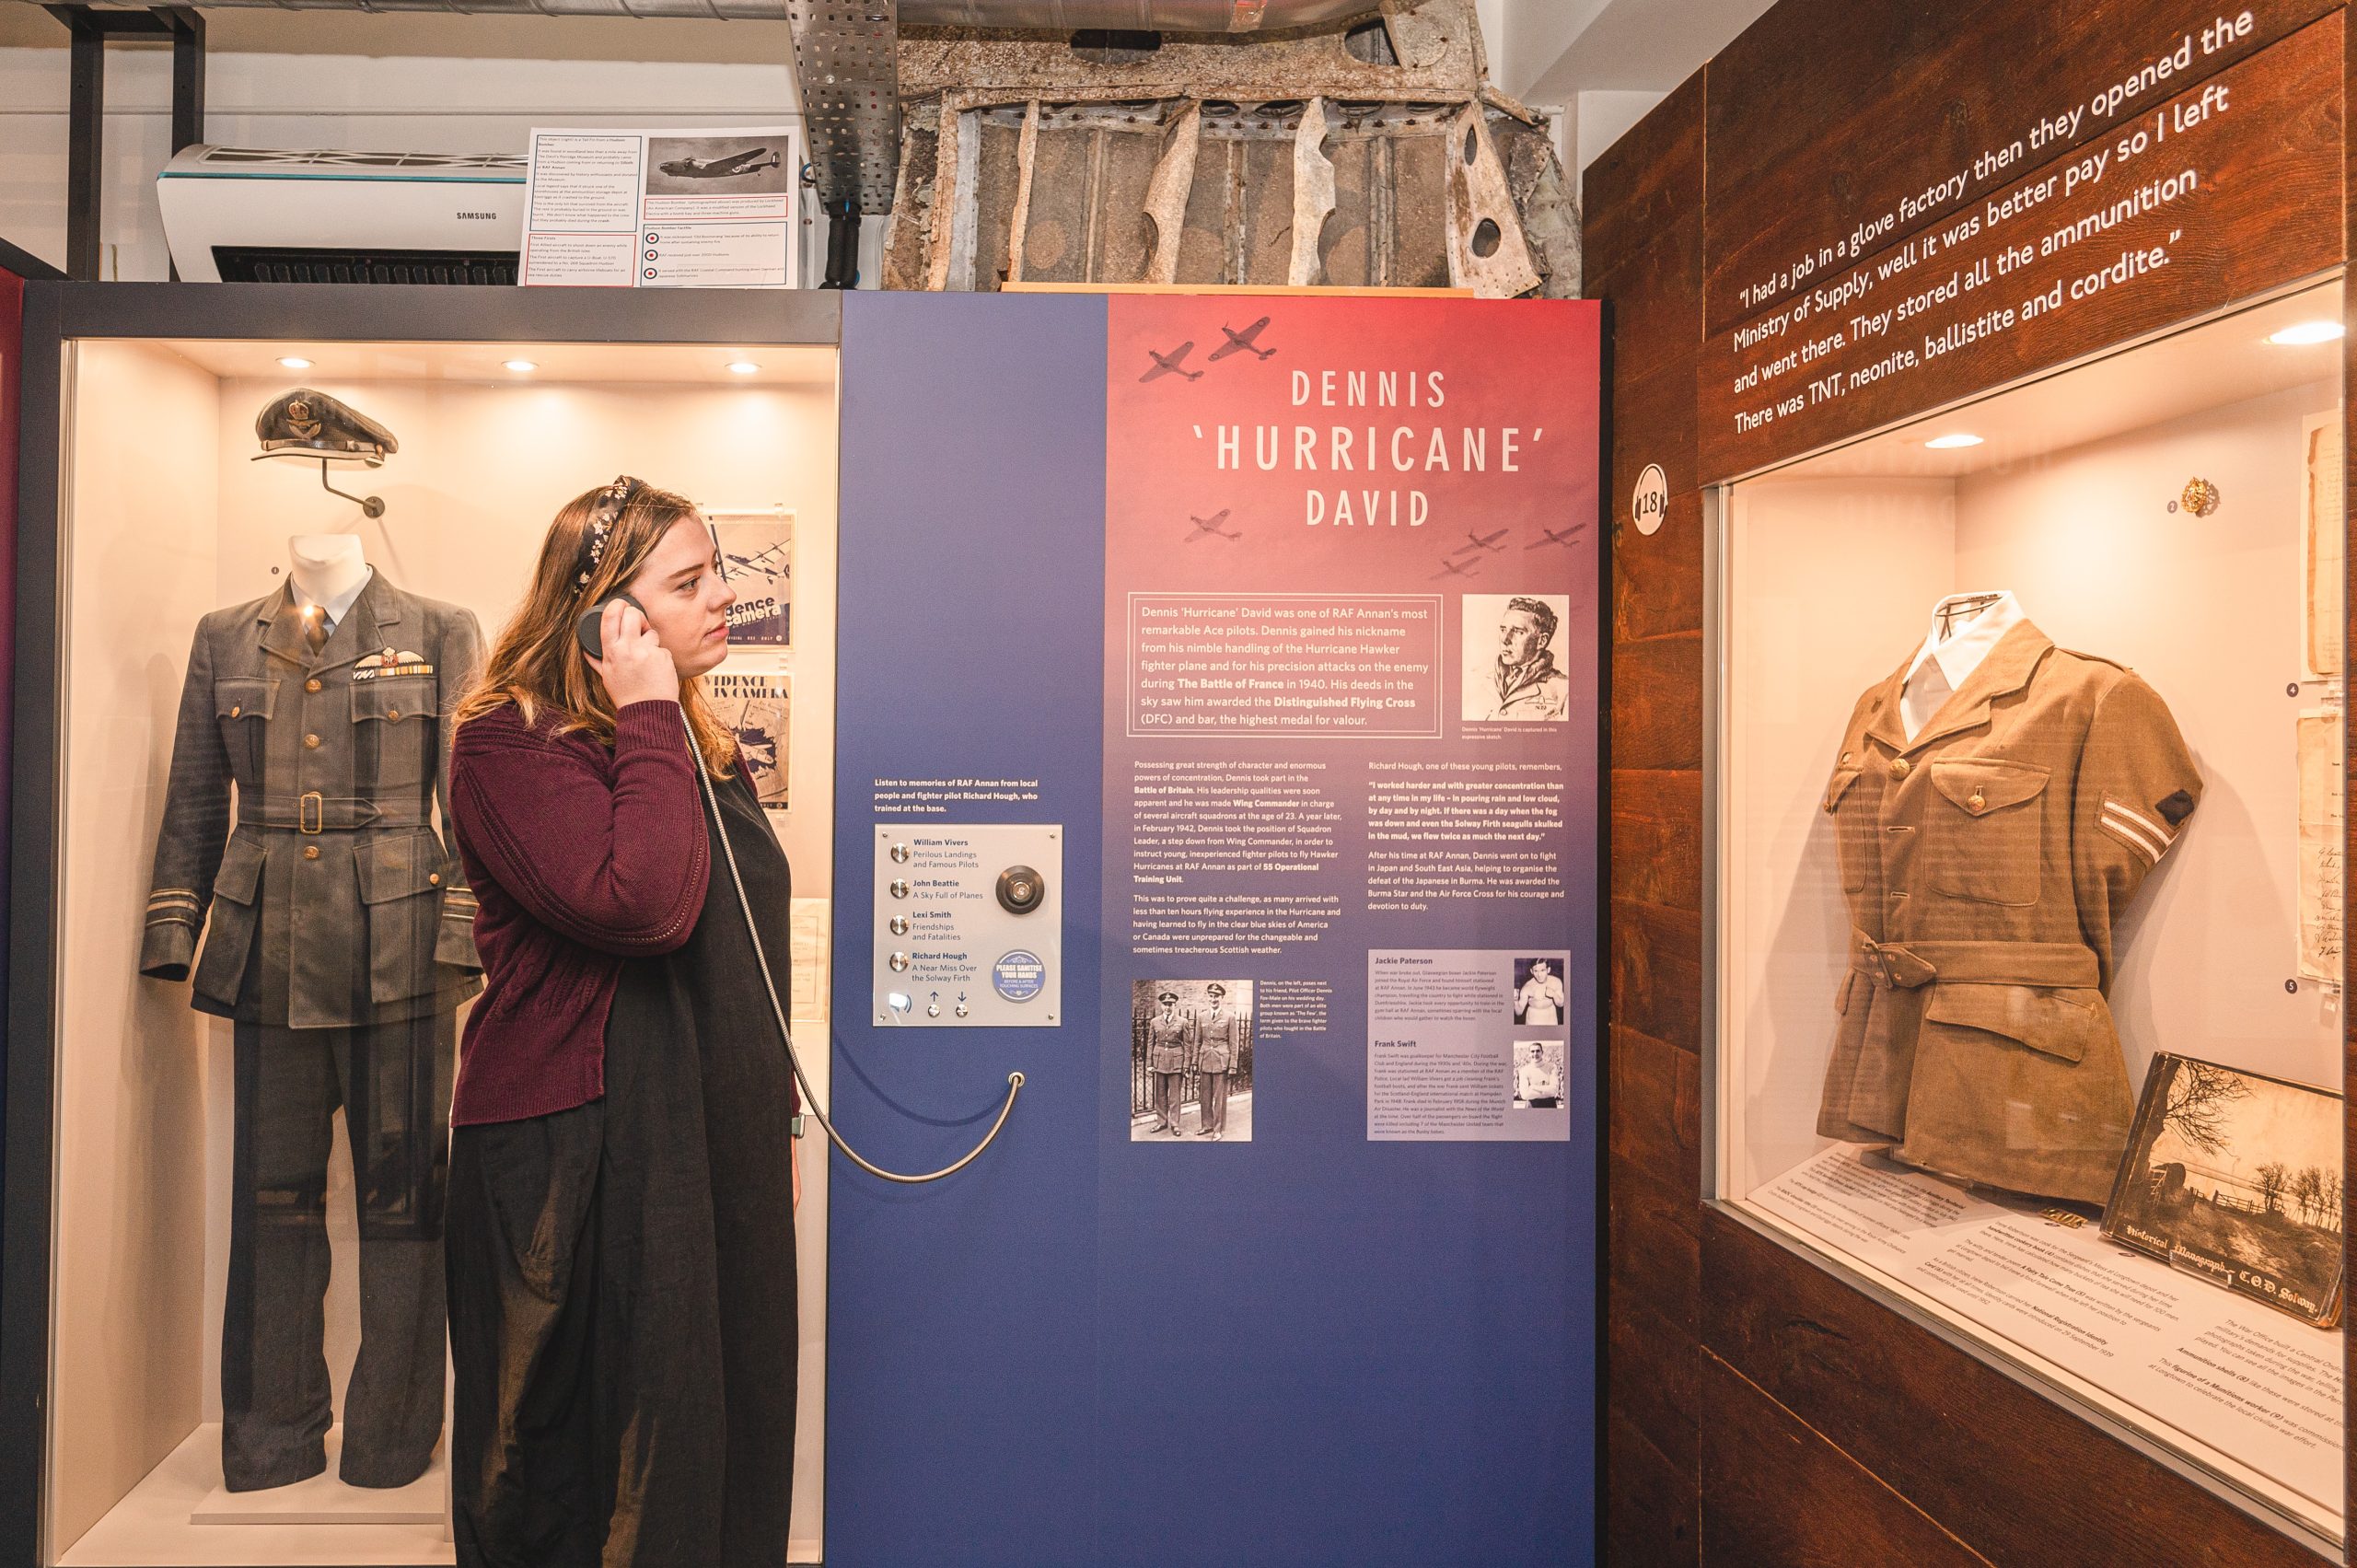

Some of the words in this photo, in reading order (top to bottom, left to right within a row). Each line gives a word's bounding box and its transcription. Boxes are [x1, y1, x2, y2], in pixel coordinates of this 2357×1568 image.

[1740, 288, 1748, 308] "I
[1753, 273, 1776, 304] had
[1781, 273, 1787, 289] a
[1791, 254, 1815, 290] job
[1819, 248, 1832, 268] in
[1838, 240, 1845, 258] a
[1851, 214, 1894, 258] glove
[1899, 169, 1968, 223] factory
[1974, 141, 2022, 180] then
[2029, 104, 2084, 149] they
[2092, 35, 2190, 117] opened
[2200, 11, 2253, 54] the
[456, 212, 496, 220] SAMSUNG
[1735, 312, 1790, 353] Ministry
[1794, 296, 1810, 322] of
[1815, 272, 1869, 312] Supply,
[1877, 242, 1917, 281] well
[1923, 236, 1937, 260] it
[1943, 216, 1980, 249] was
[1988, 176, 2057, 227] better
[2065, 149, 2109, 197] pay
[2118, 132, 2147, 162] so
[2158, 112, 2164, 143] I
[2175, 86, 2228, 133] left
[1735, 365, 1758, 393] and
[1761, 351, 1797, 380] went
[1802, 333, 1846, 363] there.
[1850, 309, 1892, 341] They
[1898, 272, 1957, 321] stored
[1965, 258, 1991, 291] all
[1997, 245, 2033, 275] the
[2041, 169, 2196, 257] ammunition
[1735, 408, 1772, 434] There
[1777, 394, 1804, 418] was
[1808, 372, 1845, 405] TNT,
[1851, 350, 1919, 389] neonite,
[1925, 308, 2014, 360] ballistite
[2022, 279, 2061, 320] and
[2071, 229, 2181, 300] cordite."
[1293, 371, 1445, 408] DENNIS
[1193, 425, 1542, 471] 'HURRICANE'
[1307, 490, 1428, 526] DAVID
[1642, 491, 1657, 514] 18
[1141, 606, 1178, 618] Dennis
[1180, 606, 1238, 618] 'Hurricane'
[1240, 607, 1271, 619] David
[1273, 610, 1295, 619] was
[1296, 610, 1317, 619] one
[1318, 607, 1329, 619] of
[1331, 607, 1354, 619] RAF
[1355, 607, 1399, 620] Annan's
[1400, 609, 1427, 620] most
[1141, 623, 1201, 636] remarkable
[1202, 624, 1224, 636] Ace
[1226, 625, 1259, 637] pilots.
[1260, 624, 1297, 636] Dennis
[1300, 626, 1335, 638] gained
[1337, 625, 1353, 637] his
[1354, 625, 1406, 637] nickname
[1141, 641, 1166, 654] from
[1168, 642, 1184, 654] his
[1186, 642, 1223, 654] nimble
[1225, 643, 1270, 656] handling
[1271, 642, 1283, 654] of
[1284, 643, 1303, 655] the
[1305, 643, 1357, 655] Hurricane
[1359, 643, 1399, 655] Hawker
[1133, 760, 1175, 771] Possessing
[1175, 761, 1195, 771] great
[1196, 761, 1227, 771] strength
[1228, 761, 1237, 770] of
[1237, 761, 1272, 770] character
[1273, 761, 1288, 770] and
[1289, 762, 1326, 771] enormous
[1368, 761, 1396, 771] Richard
[1397, 761, 1423, 772] Hough,
[1440, 761, 1448, 771] of
[1449, 761, 1470, 771] these
[1470, 763, 1493, 772] young
[1494, 761, 1517, 772] pilots,
[1518, 761, 1562, 772] remembers,
[874, 778, 898, 787] Listen
[899, 779, 907, 787] to
[908, 778, 946, 787] memories
[946, 778, 956, 787] of
[956, 778, 973, 787] RAF
[973, 778, 999, 787] Annan
[1000, 778, 1018, 788] from
[1019, 779, 1038, 788] local
[874, 791, 900, 801] people
[900, 791, 915, 800] and
[916, 791, 943, 801] fighter
[943, 791, 961, 801] pilot
[962, 791, 992, 800] Richard
[993, 791, 1020, 802] Hough,
[1021, 791, 1038, 800] who
[874, 804, 901, 813] trained
[902, 804, 911, 813] at
[911, 804, 925, 813] the
[925, 804, 946, 813] base.
[912, 838, 943, 846] William
[944, 838, 969, 847] Vivers
[912, 850, 943, 859] Perilous
[944, 850, 977, 860] Landings
[912, 860, 927, 869] and
[928, 860, 957, 869] Famous
[958, 860, 979, 869] Pilots
[912, 878, 931, 888] John
[932, 879, 959, 888] Beattie
[911, 890, 919, 900] A
[920, 890, 934, 900] Sky
[935, 890, 948, 900] Full
[949, 890, 958, 900] of
[958, 890, 983, 900] Planes
[911, 911, 928, 919] Lexi
[929, 911, 951, 919] Smith
[911, 922, 954, 933] Friendships
[911, 933, 926, 941] and
[927, 933, 961, 942] Fatalities
[911, 951, 941, 960] Richard
[942, 951, 967, 961] Hough
[1375, 957, 1398, 965] Jackie
[1399, 957, 1433, 965] Paterson
[911, 963, 918, 972] A
[919, 963, 938, 972] Near
[939, 964, 958, 972] Miss
[958, 963, 977, 972] Over
[911, 973, 924, 982] the
[924, 973, 951, 984] Solway
[952, 973, 970, 982] Firth
[1374, 1040, 1395, 1048] Frank
[1396, 1040, 1416, 1048] Swift
[2125, 1225, 2169, 1249] Historical
[2032, 1305, 2056, 1321] National
[2053, 1313, 2086, 1337] Registration
[2084, 1329, 2109, 1346] Identity
[2176, 1346, 2217, 1368] Ammunition
[2215, 1364, 2236, 1378] shells
[2235, 1374, 2250, 1386] (8)
